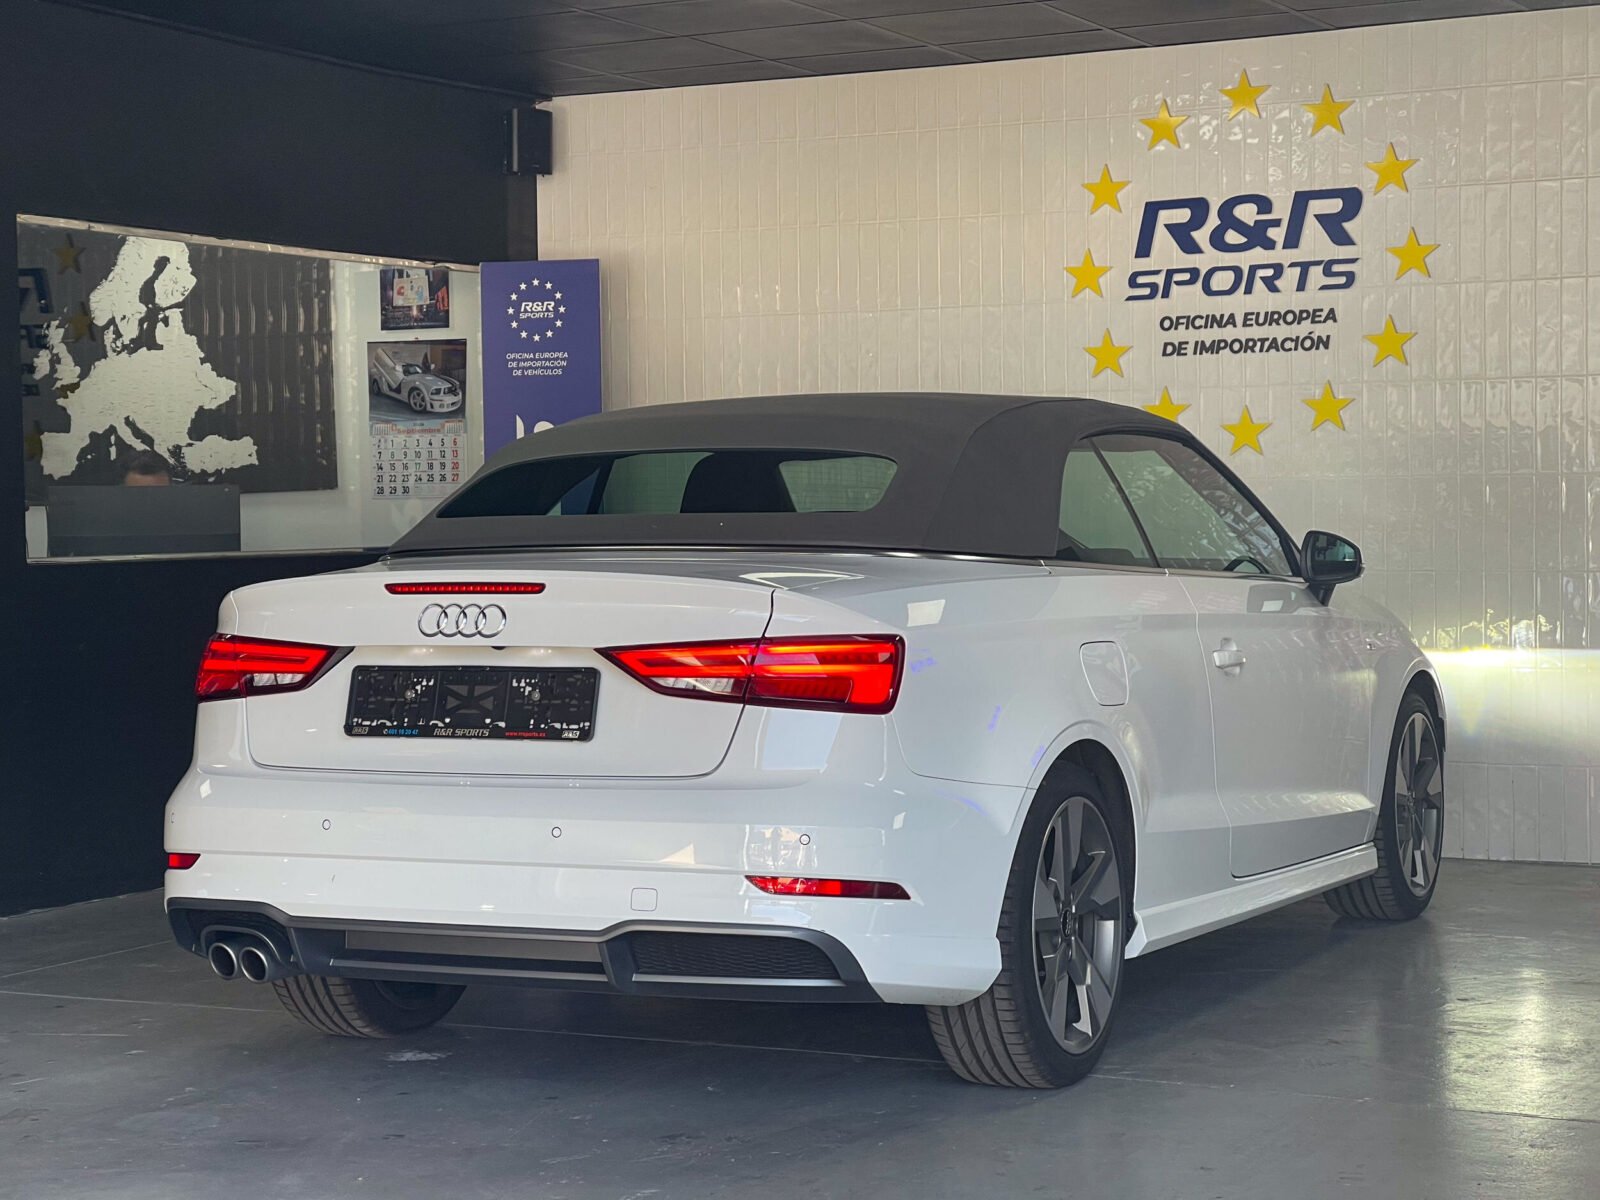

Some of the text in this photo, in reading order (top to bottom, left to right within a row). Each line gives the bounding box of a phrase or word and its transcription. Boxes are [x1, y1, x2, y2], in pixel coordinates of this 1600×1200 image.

[1134, 186, 1364, 259] R&R
[1124, 257, 1361, 302] SPORTS
[520, 302, 555, 312] R&R
[1159, 307, 1338, 332] OFICINA EUROPEA
[1161, 331, 1331, 358] DE IMPORTACIÓN
[519, 359, 567, 368] IMPORTACIÓN
[453, 438, 457, 446] 6
[440, 450, 446, 458] 12
[376, 463, 383, 471] 14
[454, 728, 490, 736] SPORTS
